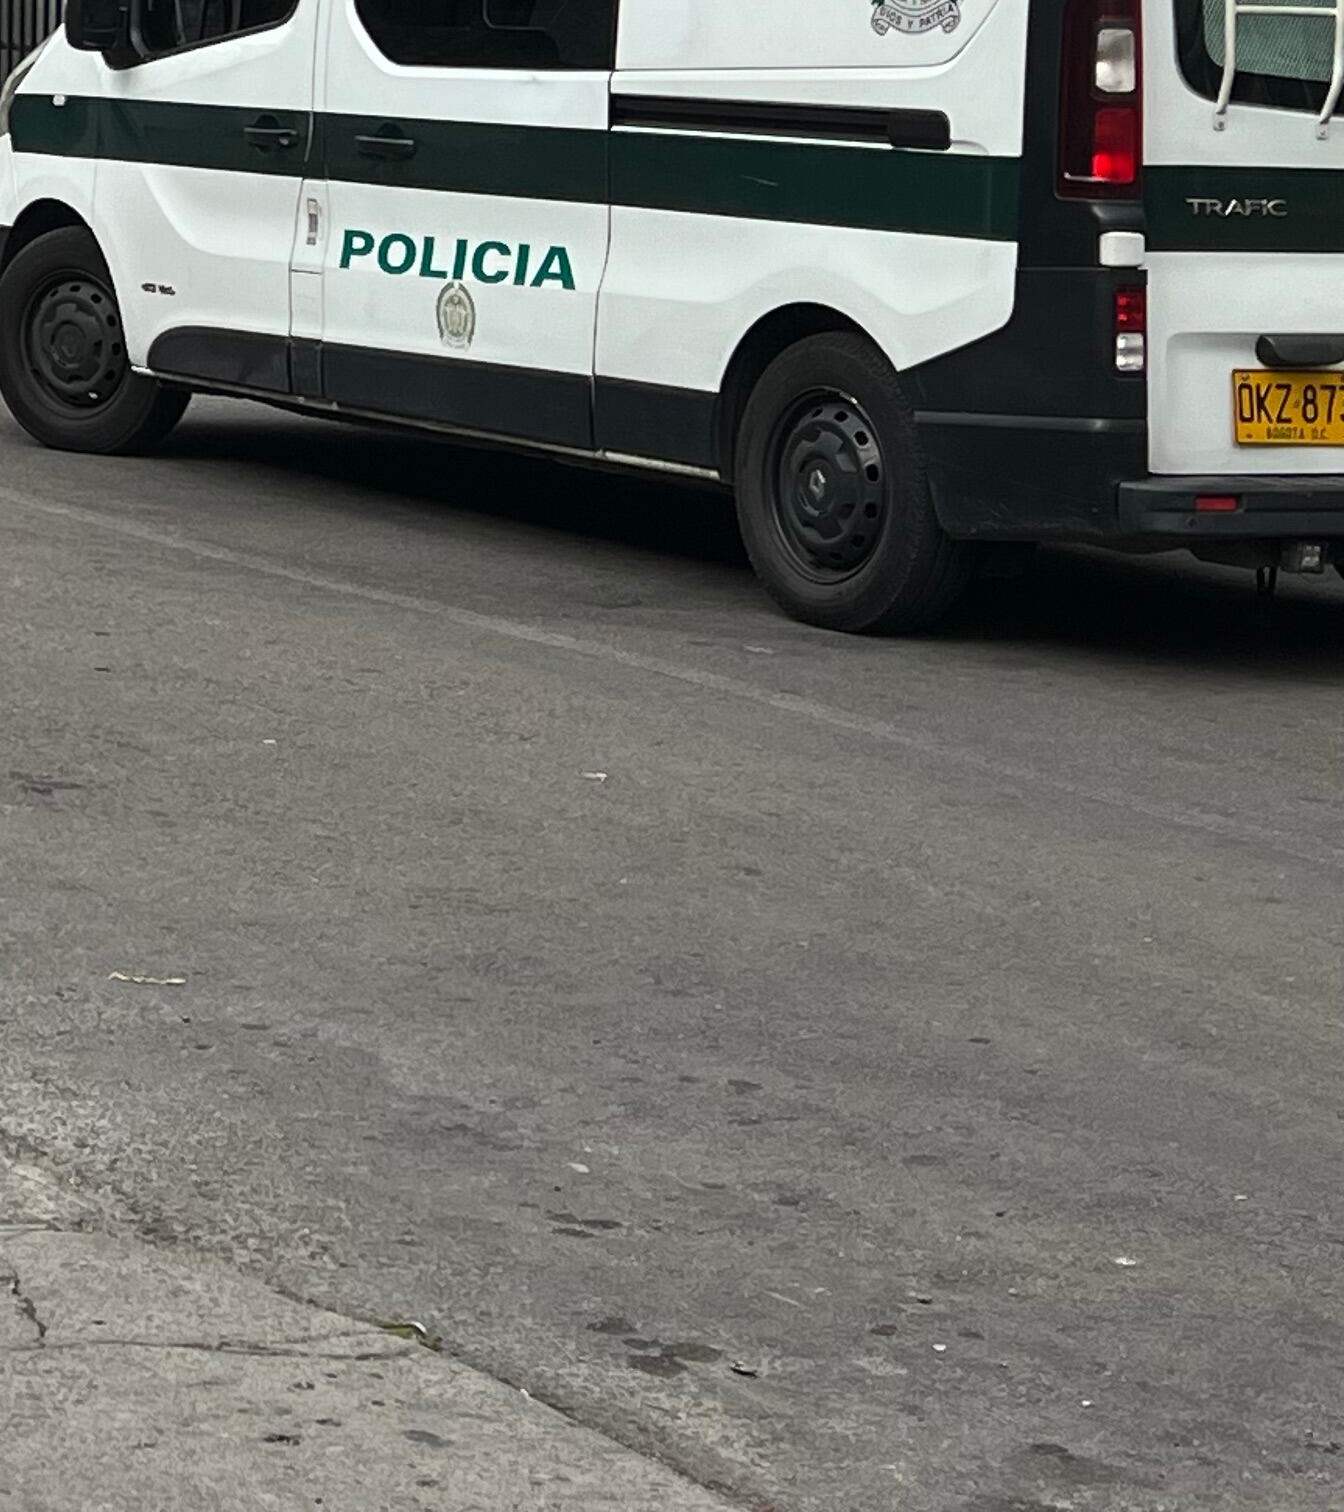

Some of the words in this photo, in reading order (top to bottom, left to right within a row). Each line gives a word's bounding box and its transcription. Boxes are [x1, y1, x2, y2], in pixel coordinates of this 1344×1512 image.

[879, 6, 902, 25] DIOS
[907, 18, 914, 29] Y
[919, 5, 955, 28] PATRIA
[1185, 198, 1288, 216] TRAFIC
[339, 229, 576, 291] POLICIA
